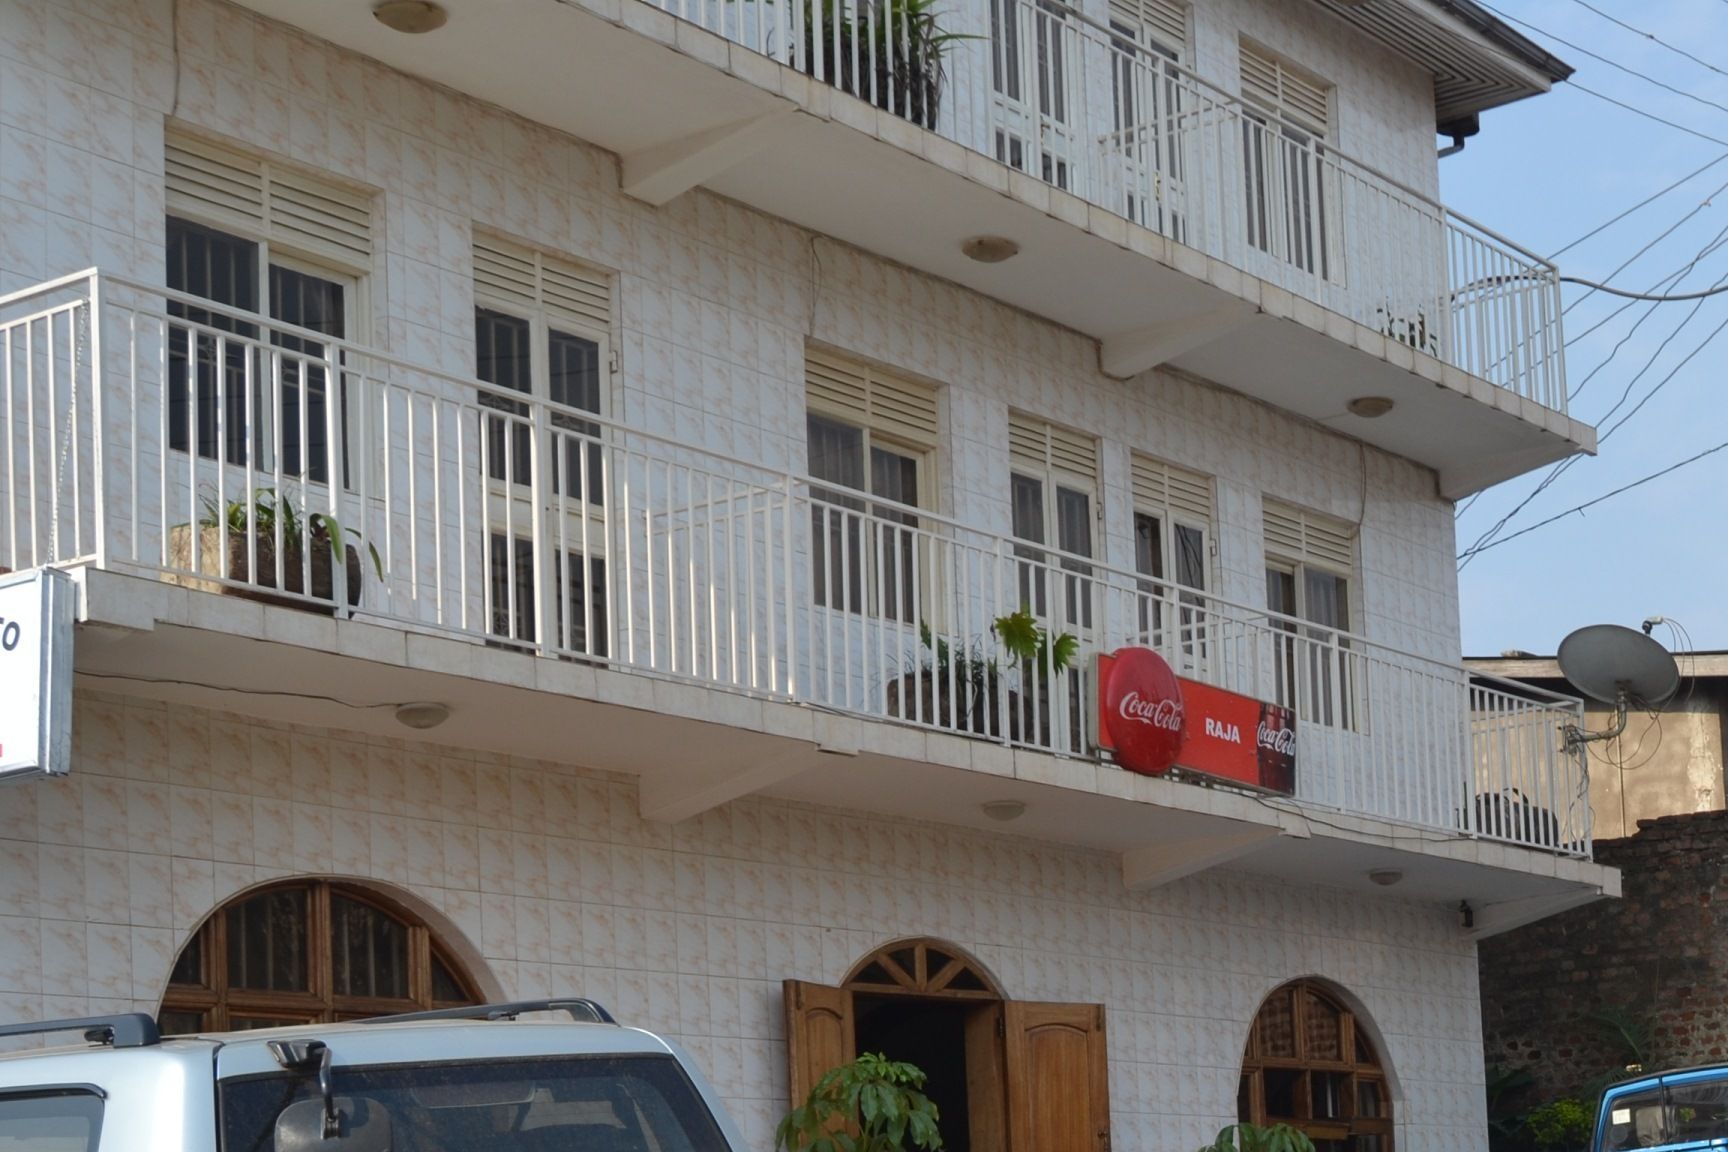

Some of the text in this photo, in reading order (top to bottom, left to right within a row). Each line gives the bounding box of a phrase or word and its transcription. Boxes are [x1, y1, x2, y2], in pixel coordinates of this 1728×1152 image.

[0, 617, 20, 651] O
[1119, 691, 1184, 732] Coca-Cola
[1205, 718, 1241, 744] RAJA
